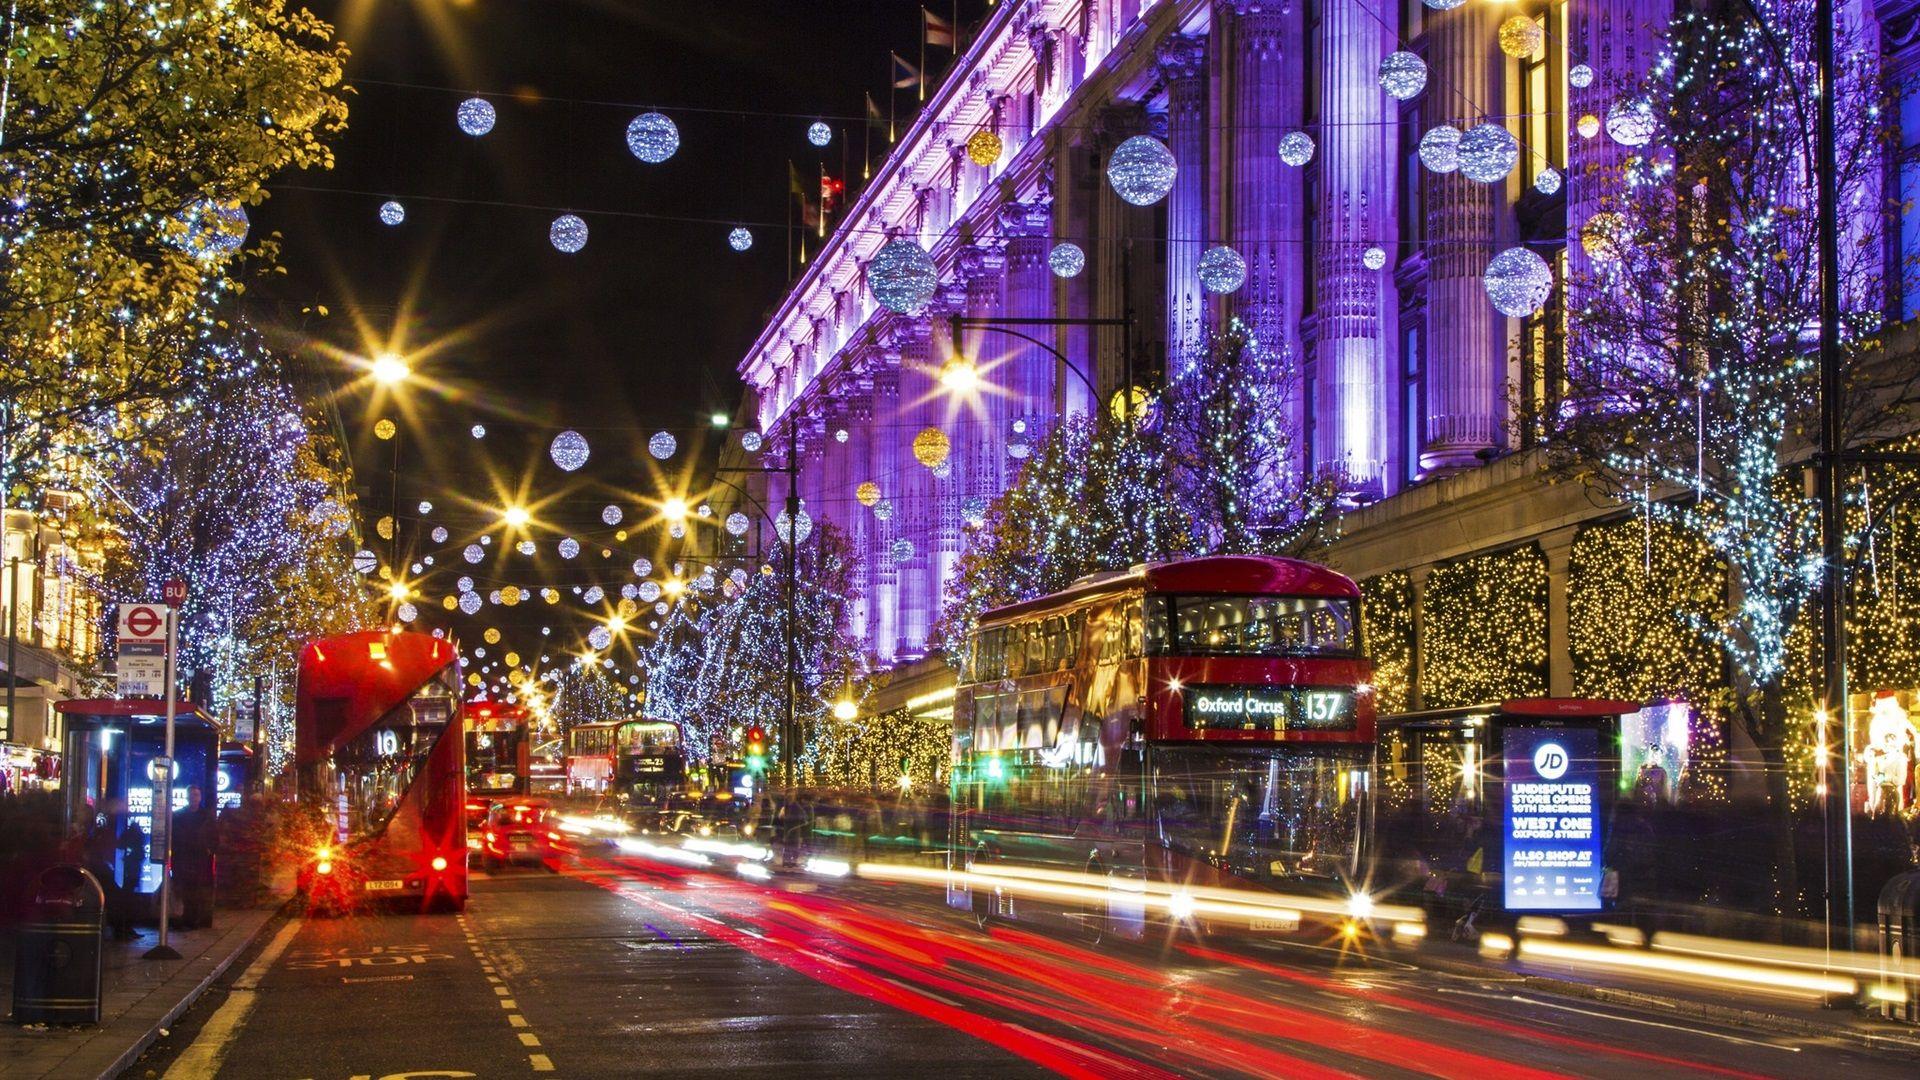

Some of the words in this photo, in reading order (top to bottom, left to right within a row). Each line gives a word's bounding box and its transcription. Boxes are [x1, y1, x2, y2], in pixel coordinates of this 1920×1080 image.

[1198, 697, 1243, 713] Oxford
[1245, 698, 1284, 714] Circus
[1306, 693, 1341, 720] 137
[377, 730, 397, 755] 10
[1540, 753, 1563, 769] JD
[1511, 783, 1592, 795] UNDISPUTED
[1511, 795, 1551, 804] STORE
[1552, 795, 1592, 804] OPENS
[1511, 804, 1538, 813] 10TH
[1538, 804, 1592, 813] DECEMBER
[1511, 817, 1558, 830] WEST
[1560, 817, 1593, 830] ONE
[1512, 830, 1554, 838] OXFORD
[1554, 830, 1593, 838] STREET
[1513, 850, 1545, 860] ALSO
[1545, 850, 1577, 860] SHOP
[1577, 850, 1593, 860] AT
